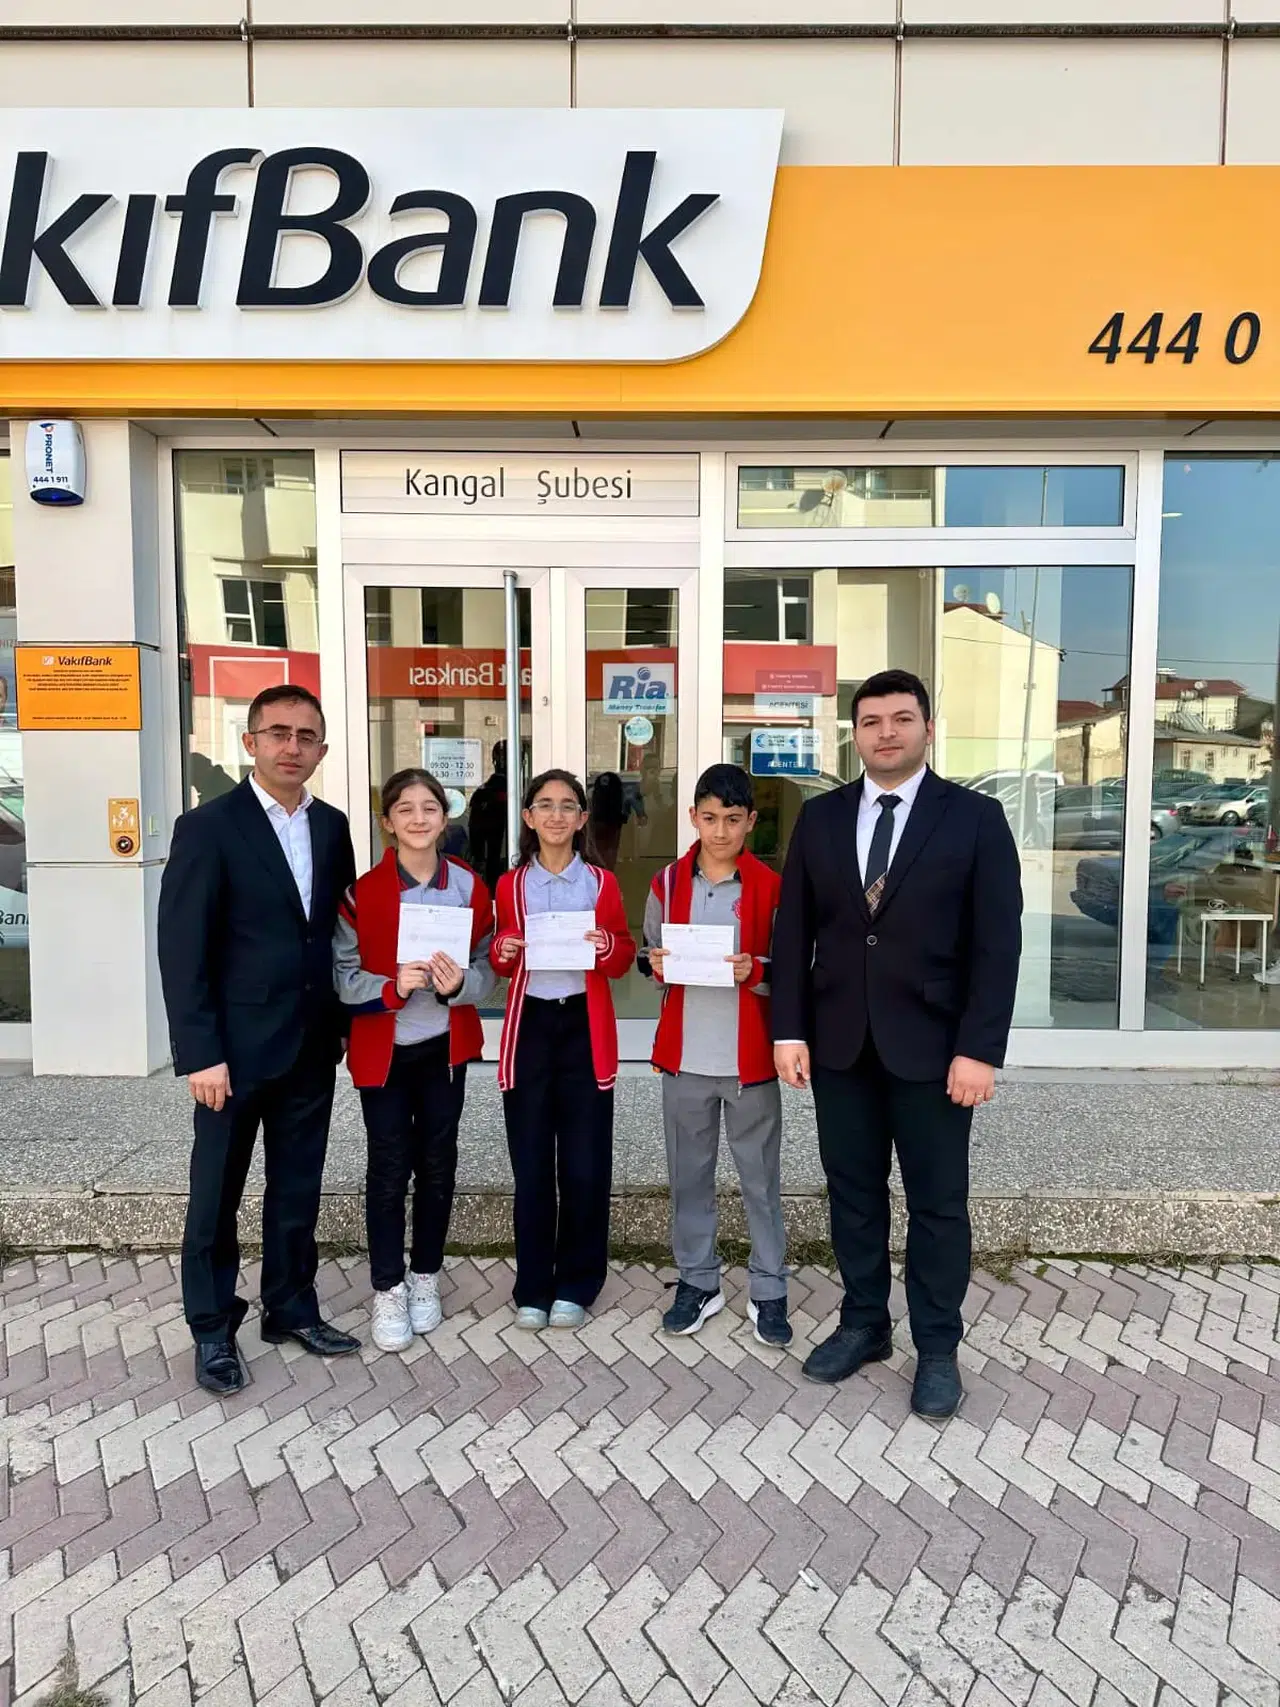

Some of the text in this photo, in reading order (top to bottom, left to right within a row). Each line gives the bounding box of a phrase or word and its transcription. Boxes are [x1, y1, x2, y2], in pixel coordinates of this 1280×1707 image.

[1088, 311, 1262, 365] 444 0
[45, 433, 54, 474] PRONET
[405, 466, 632, 506] Kangal Şubesi
[58, 655, 113, 666] VakıfBank
[608, 666, 667, 700] Ria
